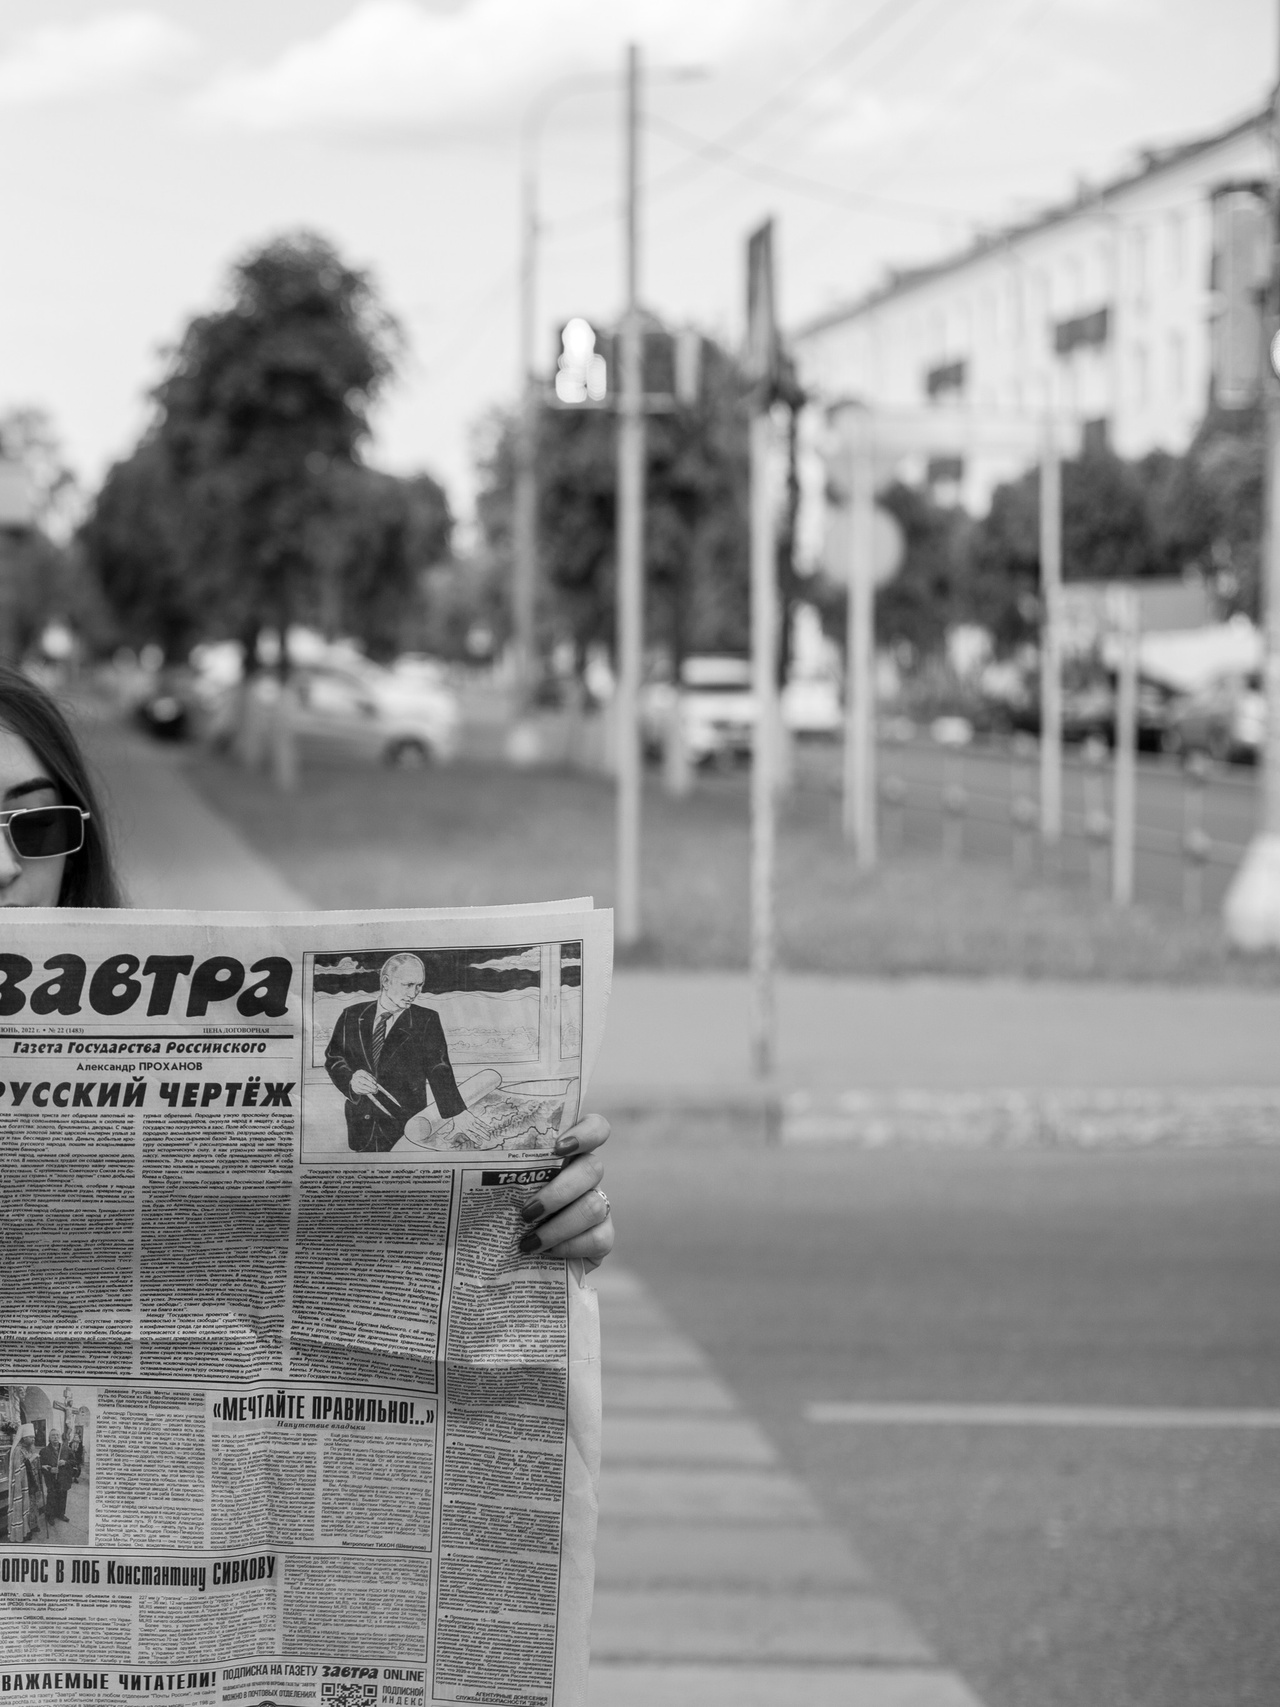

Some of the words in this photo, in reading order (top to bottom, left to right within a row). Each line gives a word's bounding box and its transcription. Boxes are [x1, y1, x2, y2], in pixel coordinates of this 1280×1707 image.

[66, 1026, 85, 1034] (1483)
[13, 1042, 63, 1054] Газета
[67, 1041, 161, 1056] Государства
[76, 1062, 136, 1073] Александр
[139, 1062, 203, 1072] ПРОХАНОВ
[159, 1076, 297, 1108] ЧЕРТЁЖ
[213, 1390, 305, 1421] «МЕЧТАЙТЕ
[312, 1396, 434, 1426] ПРАВИЛЬНО!..»
[276, 1420, 328, 1430] Напутствие
[330, 1423, 366, 1431] владыки
[56, 1559, 65, 1584] В
[70, 1559, 100, 1584] ЛОБ
[107, 1560, 206, 1590] Константину
[213, 1556, 275, 1586] СИВКОВУ
[223, 1664, 268, 1680] ПОДПИСКА
[270, 1664, 282, 1676] НА
[284, 1665, 318, 1676] ГАЗЕТУ
[384, 1669, 424, 1682] ONLINE
[119, 1672, 216, 1690] ЧИТАТЕЛИ!
[222, 1692, 242, 1702] МОЖНО
[248, 1689, 278, 1698] ПОЧТОВЫХ
[278, 1690, 316, 1698] ОТДЕЛЕНИЯХ
[382, 1684, 424, 1697] ПОДПИСНОЙ
[382, 1696, 423, 1707] ИНДЕКС
